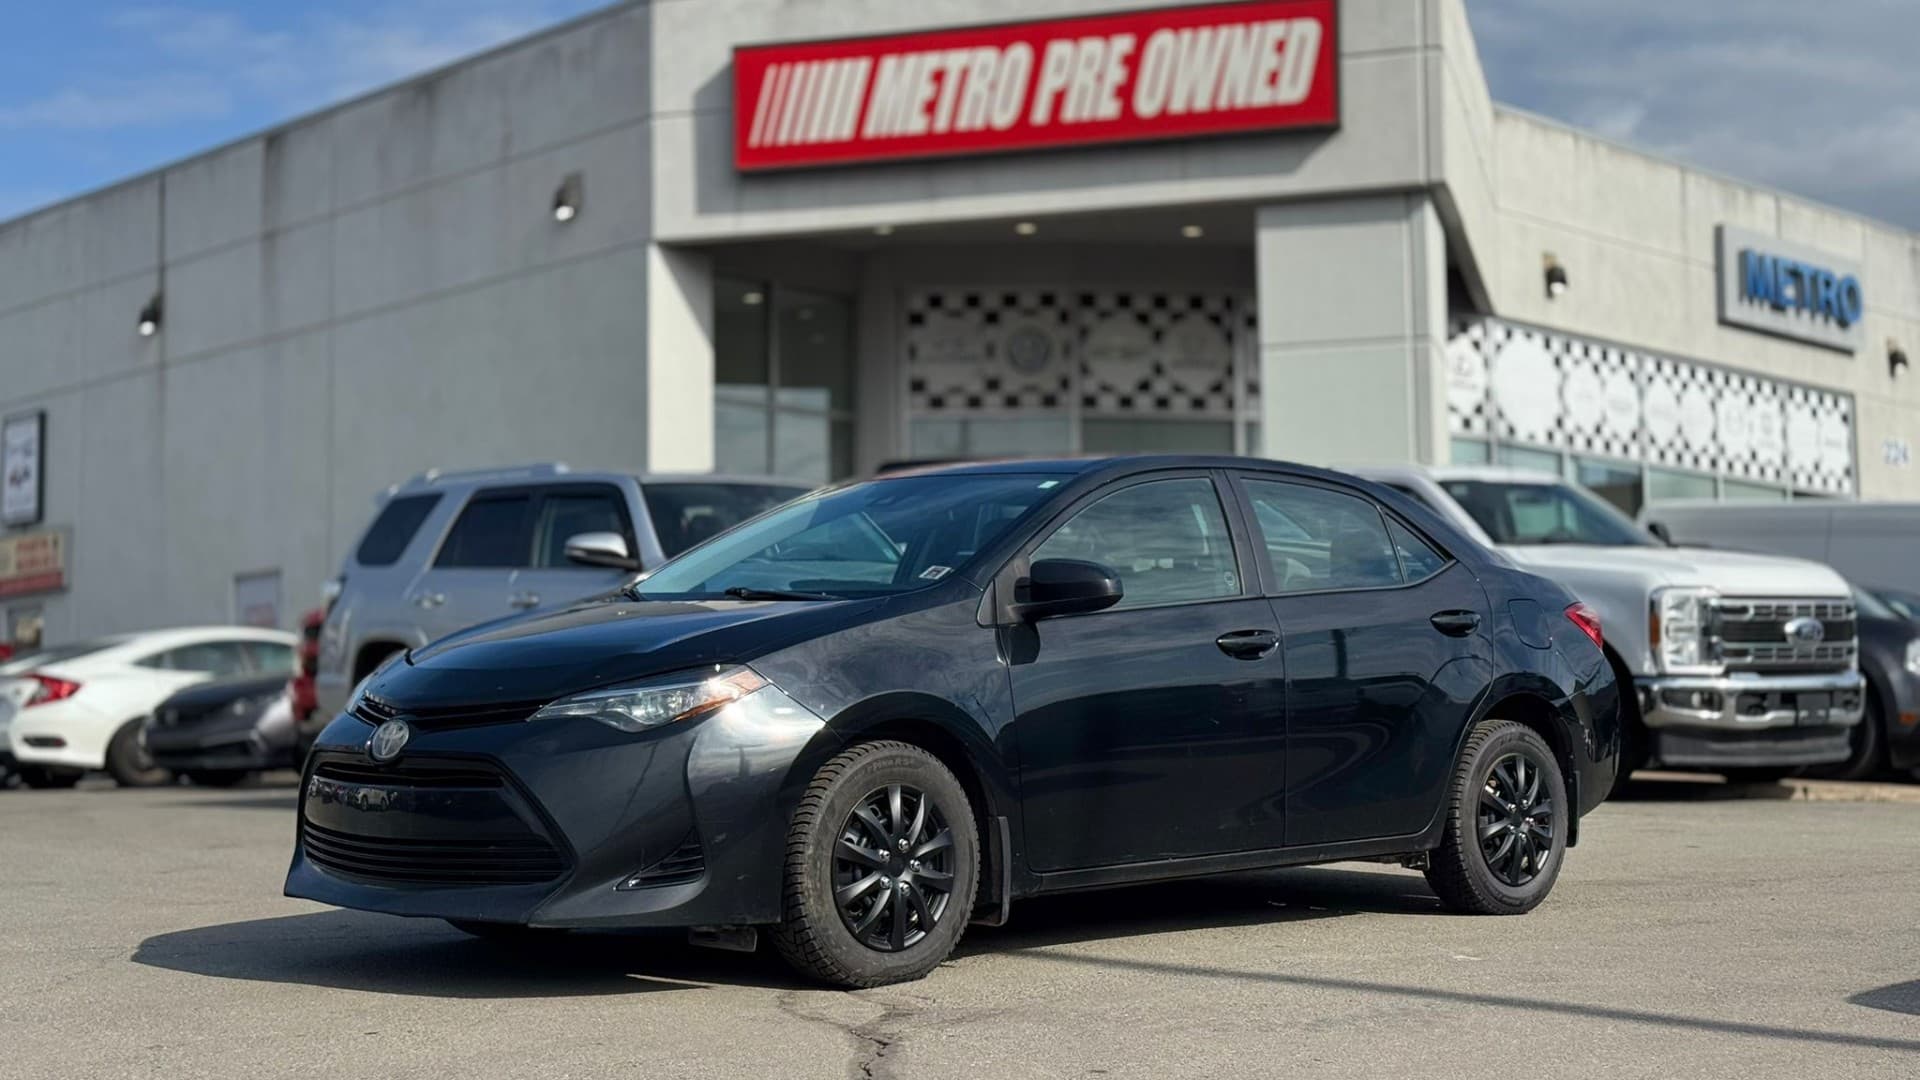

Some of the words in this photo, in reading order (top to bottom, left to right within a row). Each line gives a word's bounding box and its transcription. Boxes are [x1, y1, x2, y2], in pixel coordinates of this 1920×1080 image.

[861, 41, 1034, 140] METRO
[1029, 34, 1137, 126] PRE
[1132, 17, 1322, 119] OWNED
[1743, 247, 1863, 325] METRO
